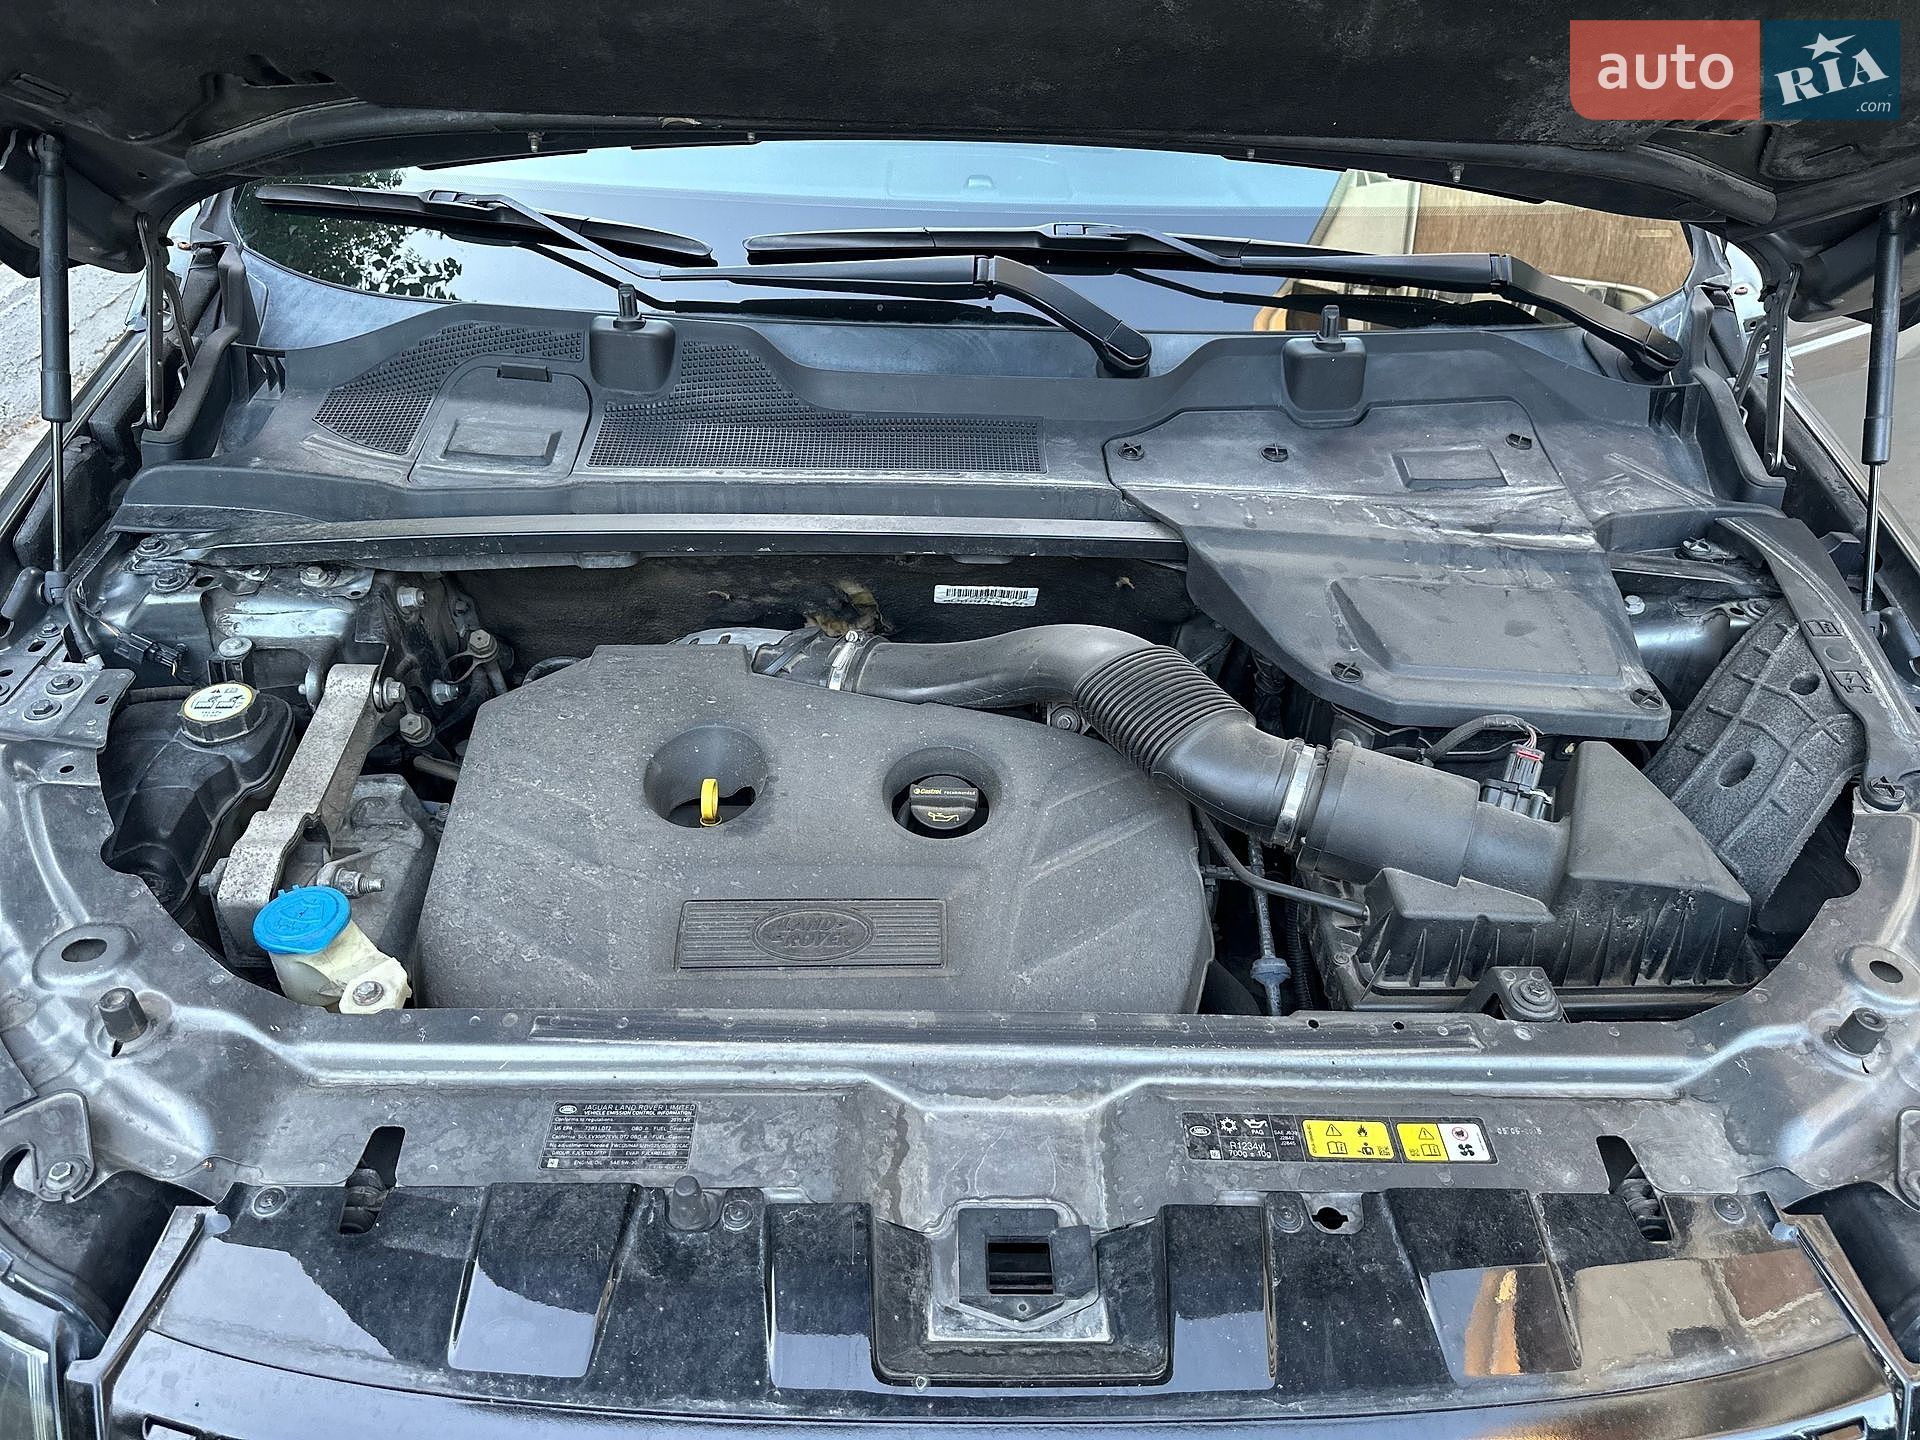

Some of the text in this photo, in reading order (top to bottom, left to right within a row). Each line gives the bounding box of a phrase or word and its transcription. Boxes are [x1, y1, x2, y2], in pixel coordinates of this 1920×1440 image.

[780, 915, 837, 933] LAND
[782, 931, 852, 948] ROVER
[1228, 1149, 1248, 1158] 700g
[1257, 1150, 1272, 1159] 10g
